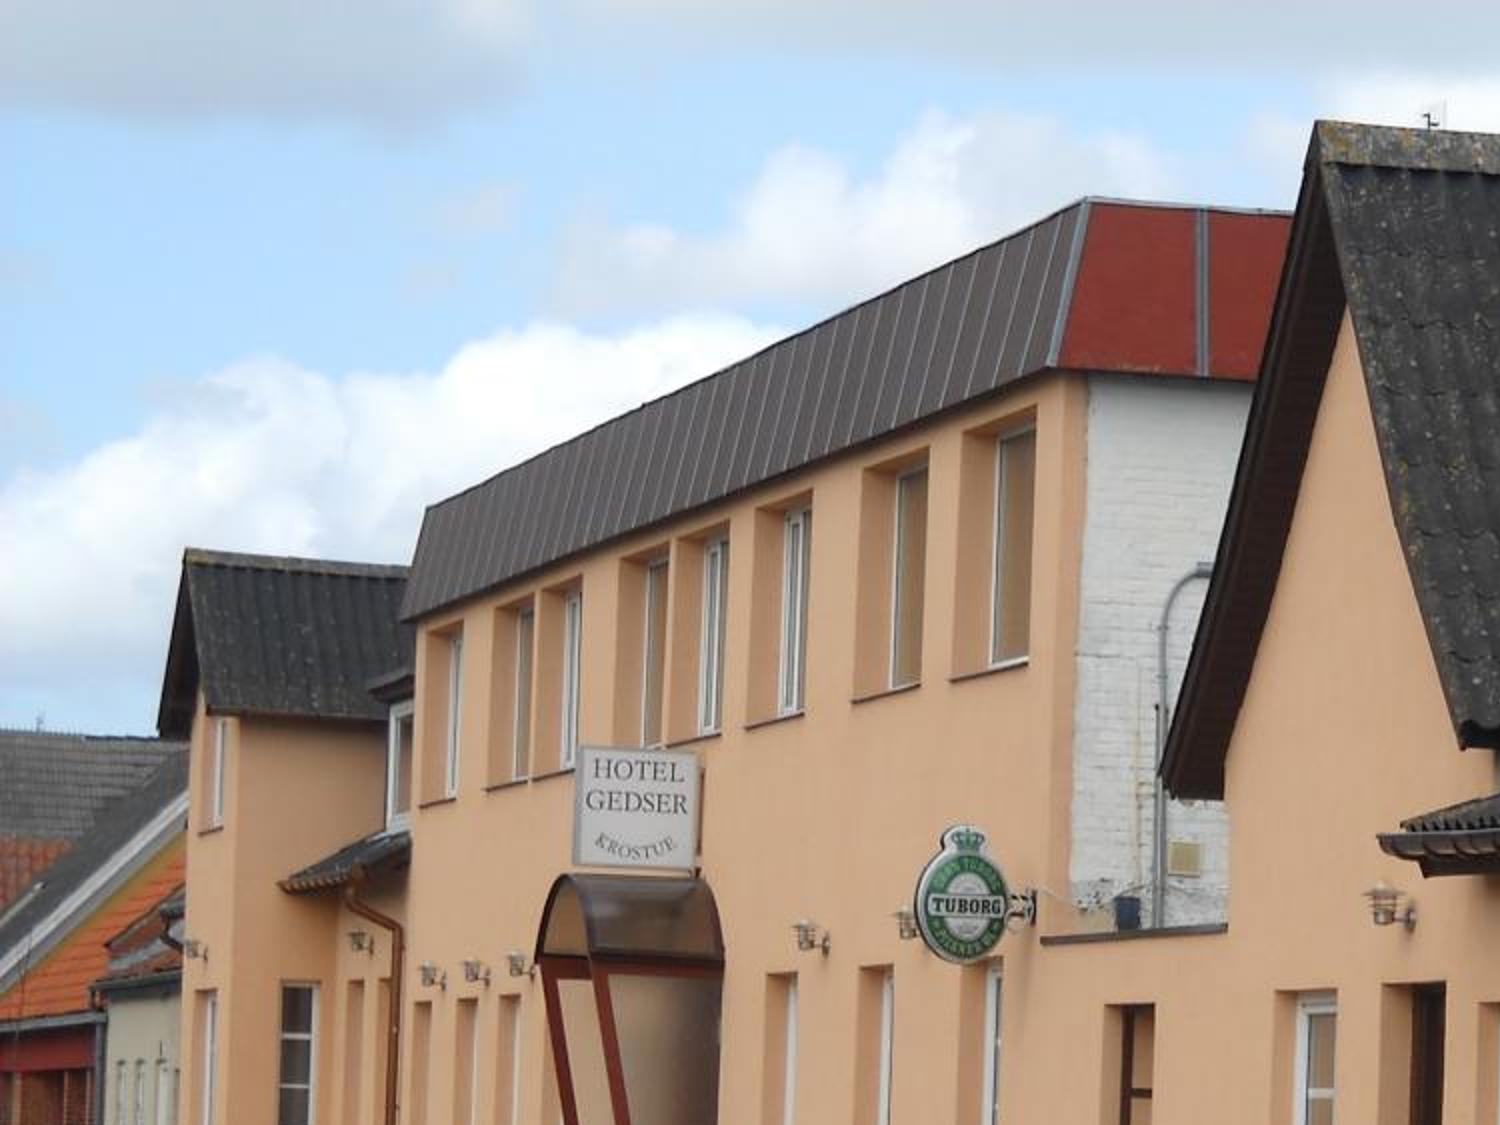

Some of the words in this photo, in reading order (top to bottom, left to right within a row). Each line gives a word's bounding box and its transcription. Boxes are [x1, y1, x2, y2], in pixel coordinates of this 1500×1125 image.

[594, 757, 685, 782] HOTEL
[585, 789, 688, 815] GEDSER
[931, 897, 1001, 914] TUBORG
